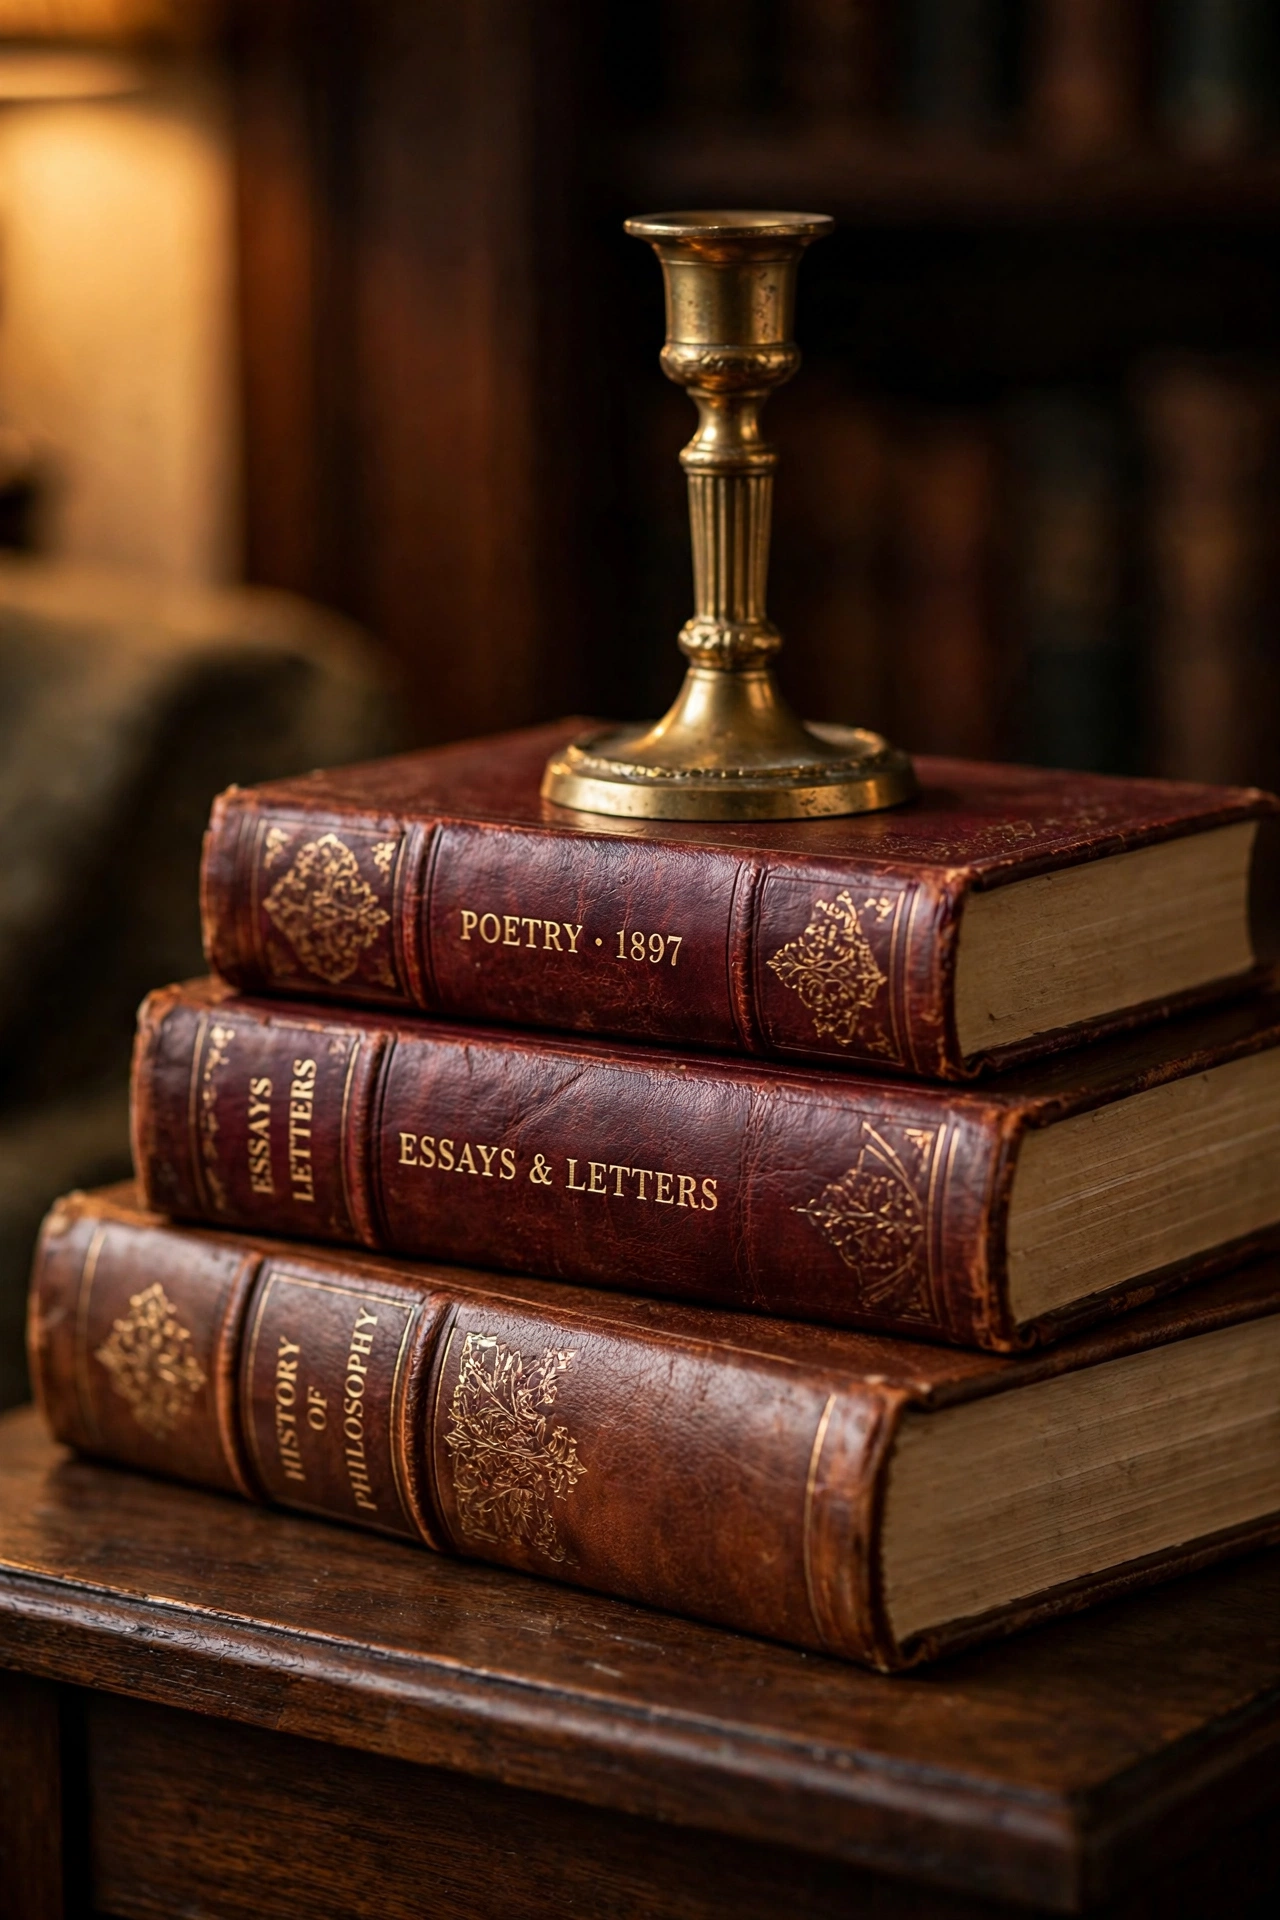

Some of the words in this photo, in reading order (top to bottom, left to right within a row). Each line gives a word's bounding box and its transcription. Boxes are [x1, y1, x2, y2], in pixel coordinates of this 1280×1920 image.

[460, 909, 583, 953] POETRY
[616, 929, 683, 966] 1897
[248, 1077, 275, 1195] ESSAYS
[289, 1059, 315, 1202] LETTERS
[398, 1132, 517, 1180] ESSAYS
[529, 1153, 552, 1185] &
[565, 1158, 718, 1211] LETTERS
[275, 1334, 306, 1482] HISTORY
[307, 1386, 327, 1431] OF
[344, 1306, 379, 1511] PHILOSOPHY
